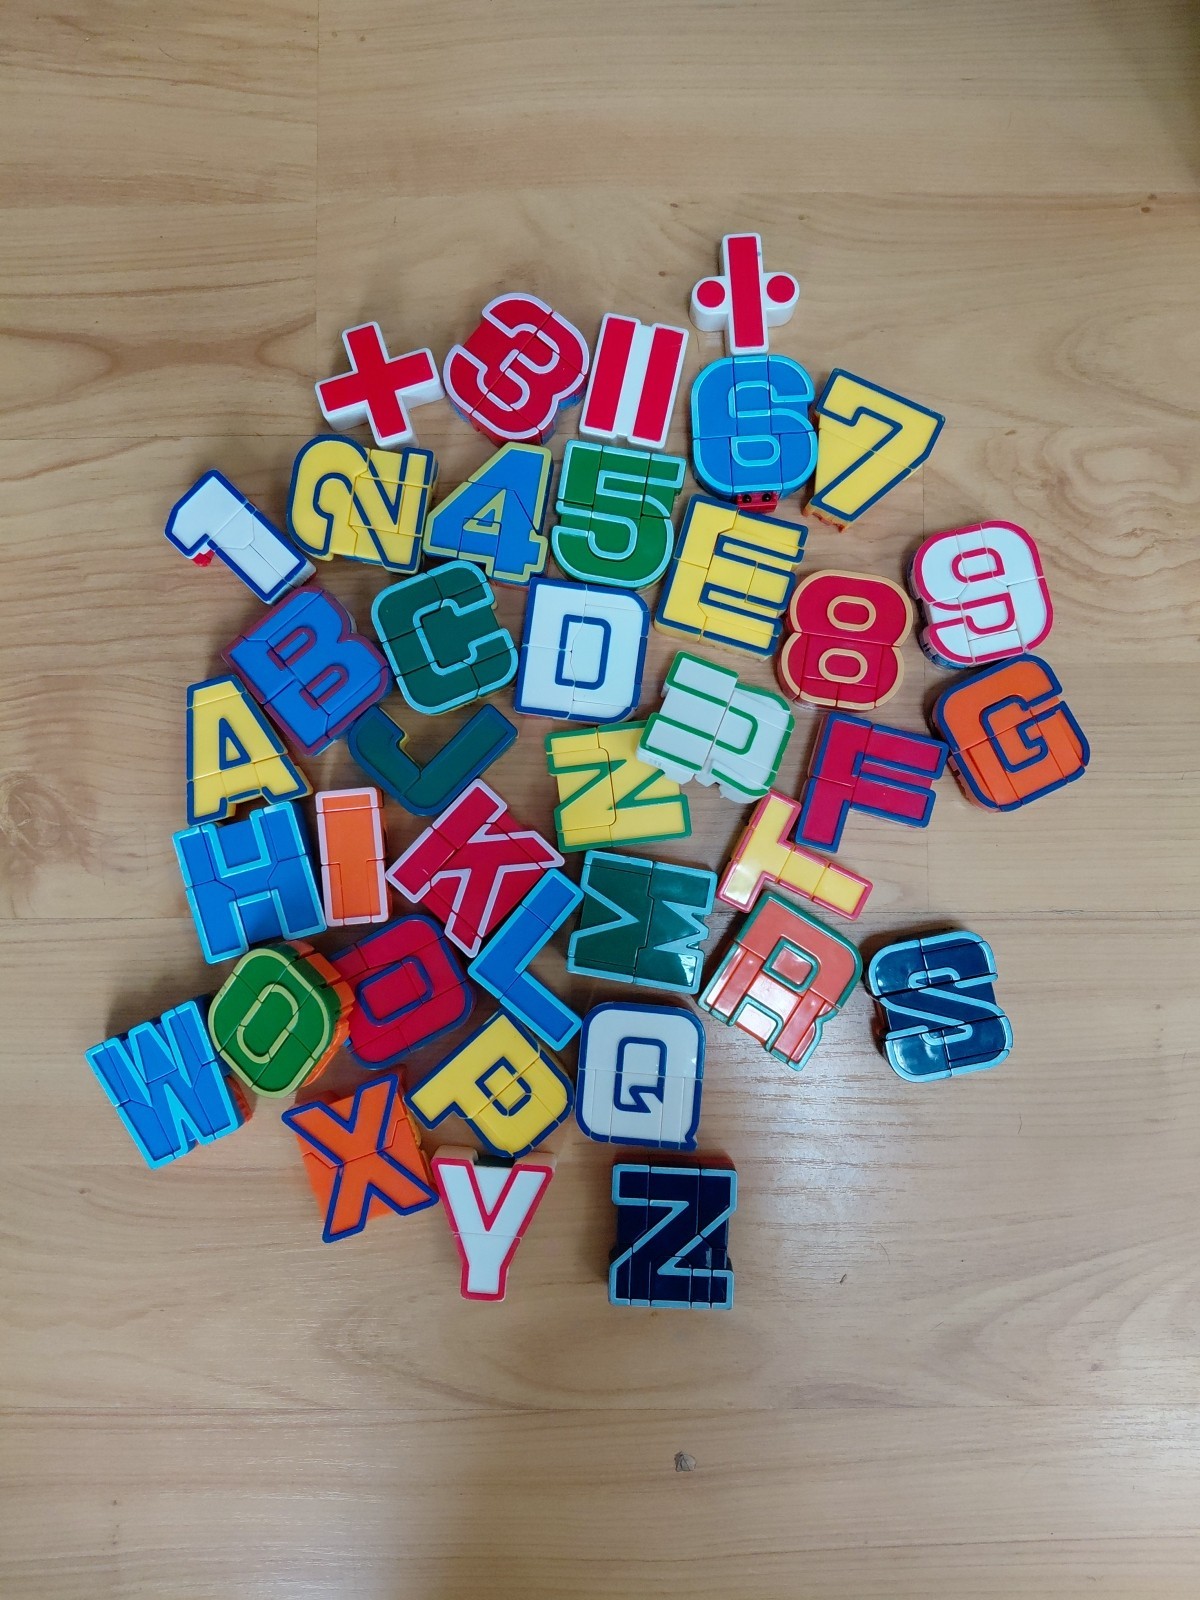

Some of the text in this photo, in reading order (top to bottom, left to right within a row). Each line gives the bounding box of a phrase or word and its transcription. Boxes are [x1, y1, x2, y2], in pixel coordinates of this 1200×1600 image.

[443, 293, 590, 440] 3
[691, 355, 818, 497] 6
[287, 434, 434, 572] 2
[424, 442, 552, 583] 4
[551, 440, 686, 588] 5
[809, 368, 946, 522] 7
[165, 470, 312, 603] 1
[655, 495, 808, 657] E
[914, 520, 1053, 665] 9
[221, 586, 389, 755] B
[371, 560, 519, 715] C
[514, 577, 650, 723] D
[778, 569, 913, 709] 8
[187, 674, 311, 825] A
[348, 704, 517, 816] J
[638, 651, 795, 798] U
[795, 712, 950, 853] F
[937, 654, 1090, 812] G
[173, 802, 326, 964] H
[316, 788, 388, 927] I
[386, 779, 565, 958] K
[566, 850, 718, 994] M
[717, 790, 873, 921] T
[467, 869, 582, 1051] L
[698, 891, 863, 1071] R
[868, 930, 1013, 1082] S
[85, 1000, 238, 1170] W
[404, 1010, 575, 1157] P
[574, 1002, 706, 1151] Q
[282, 1073, 439, 1243] X
[431, 1158, 554, 1301] Y
